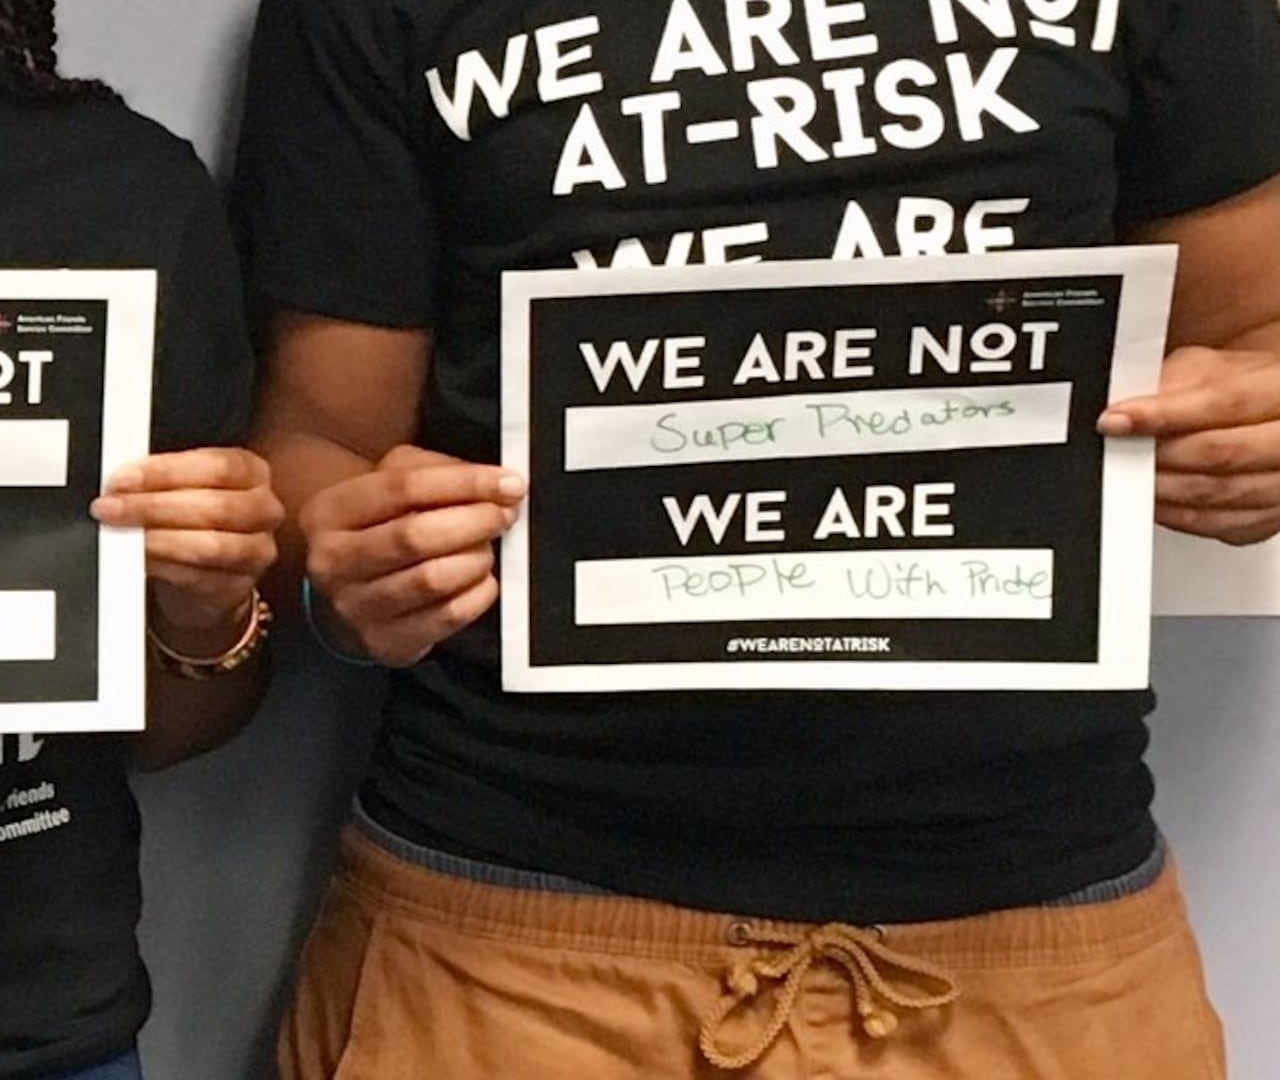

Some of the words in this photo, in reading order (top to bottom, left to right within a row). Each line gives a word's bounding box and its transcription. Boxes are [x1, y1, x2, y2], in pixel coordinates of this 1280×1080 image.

[426, 16, 602, 139] WE
[553, 48, 1039, 194] AT-RISK
[580, 337, 705, 392] WE
[734, 329, 876, 384] ARE
[910, 323, 1058, 373] NOT
[650, 413, 786, 453] Super
[806, 397, 1020, 438] Predators
[663, 491, 786, 545] WE
[814, 483, 954, 539] ARE
[727, 638, 889, 651] #WEARENOTATRISK
